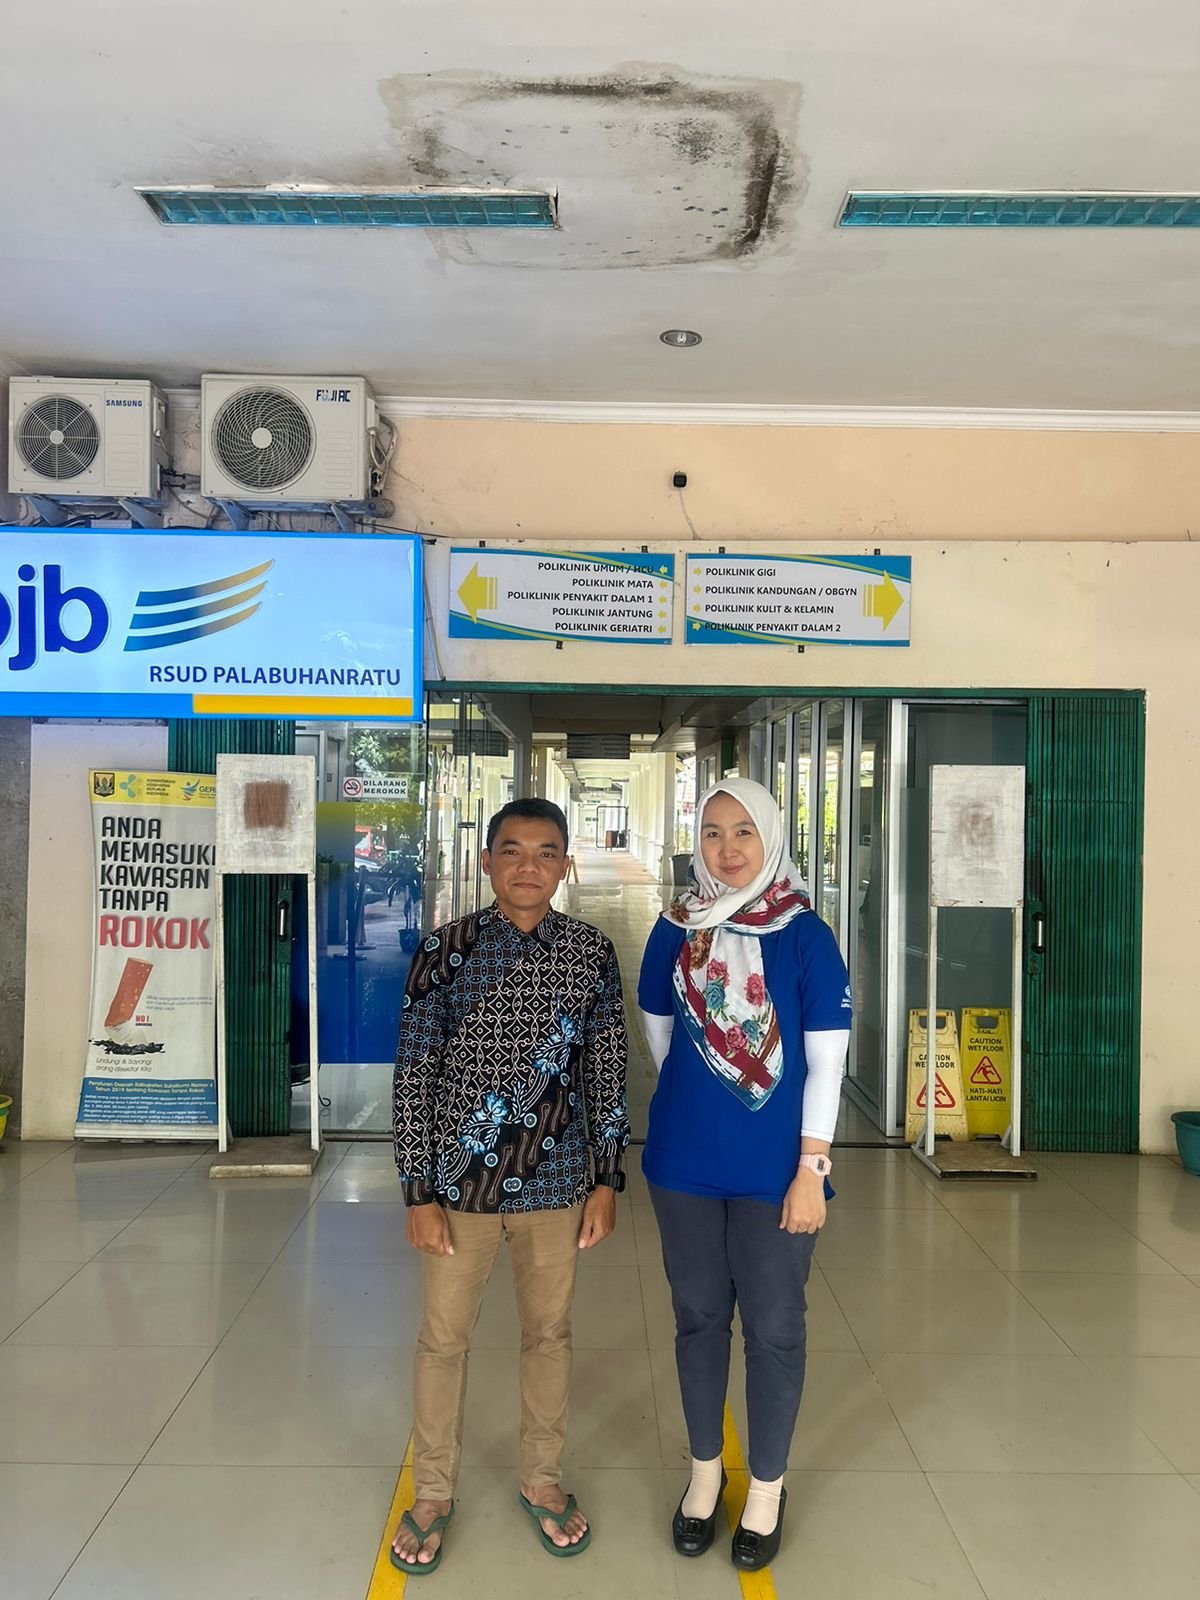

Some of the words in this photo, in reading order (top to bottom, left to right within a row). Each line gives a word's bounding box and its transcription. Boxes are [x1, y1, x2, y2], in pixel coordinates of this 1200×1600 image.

[106, 399, 143, 407] SAMSUNG
[538, 562, 591, 572] POLIKLINIK
[593, 564, 624, 573] UMUM
[633, 565, 654, 574] HCU
[705, 568, 755, 577] POLIKLINIK
[757, 568, 776, 577] GIGI
[572, 578, 625, 588] POLIKLINIK
[627, 580, 654, 589] MATA
[705, 586, 755, 595] POLIKLINIK
[757, 587, 817, 596] KANDUNGAN
[825, 587, 857, 596] OBGYN
[507, 591, 560, 601] POLIKLINIK
[562, 593, 608, 603] PENYAKIT
[611, 594, 645, 604] DALAM
[648, 595, 653, 603] 1
[552, 607, 604, 617] POLIKLINIK
[607, 609, 653, 619] JANTUNG
[705, 604, 755, 613] POLIKLINIK
[756, 605, 782, 614] KULIT
[784, 605, 792, 614] &
[794, 605, 834, 614] KELAMIN
[0, 563, 110, 671] jb
[555, 622, 607, 632] POLIKLINIK
[610, 623, 653, 633] GERIATRI
[705, 622, 754, 632] POLIKLINIK
[756, 623, 799, 632] PENYAKIT
[801, 624, 833, 632] DALAM
[835, 624, 841, 632] 2
[149, 665, 207, 683] RSUD
[213, 666, 401, 686] PALABUHANRATU
[101, 816, 162, 839] ANDA
[101, 840, 216, 866] MEMASUKI
[100, 864, 210, 889] KAWASAN
[99, 888, 169, 912] TANPA
[99, 914, 211, 950] ROKOK
[969, 1037, 1002, 1045] CAUTION
[969, 1087, 1003, 1095] HATI-HATI
